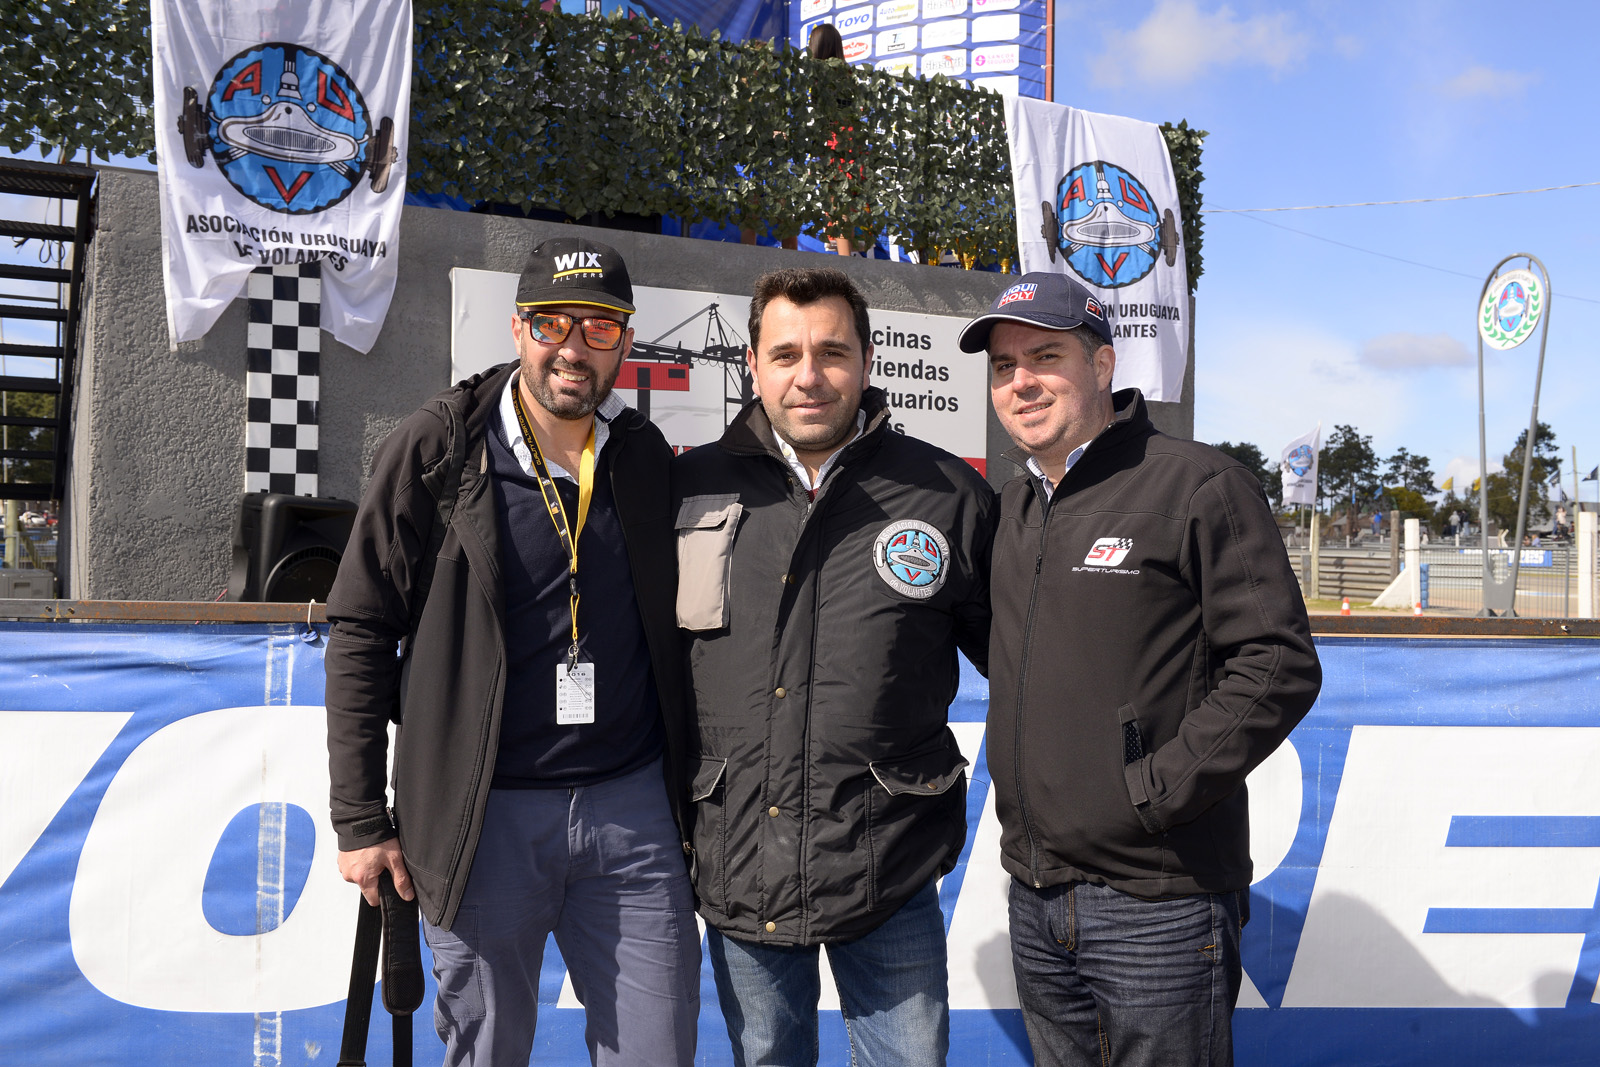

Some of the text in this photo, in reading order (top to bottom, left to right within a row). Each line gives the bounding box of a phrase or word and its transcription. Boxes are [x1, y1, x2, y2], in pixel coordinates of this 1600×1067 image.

[838, 14, 870, 29] TOYO
[186, 214, 387, 258] ASOCIACIÓN URUGUAYA
[259, 247, 349, 272] VOLANTES
[554, 251, 601, 272] WIX
[552, 273, 604, 284] FILTERS
[1000, 291, 1034, 306] MOLY
[1001, 283, 1036, 299] LIQUI
[1119, 303, 1180, 321] URUGUAYA
[871, 326, 932, 350] cinas
[885, 389, 959, 412] tuarios
[1087, 545, 1118, 562] ST
[1071, 566, 1140, 575] SUPERTURISMO
